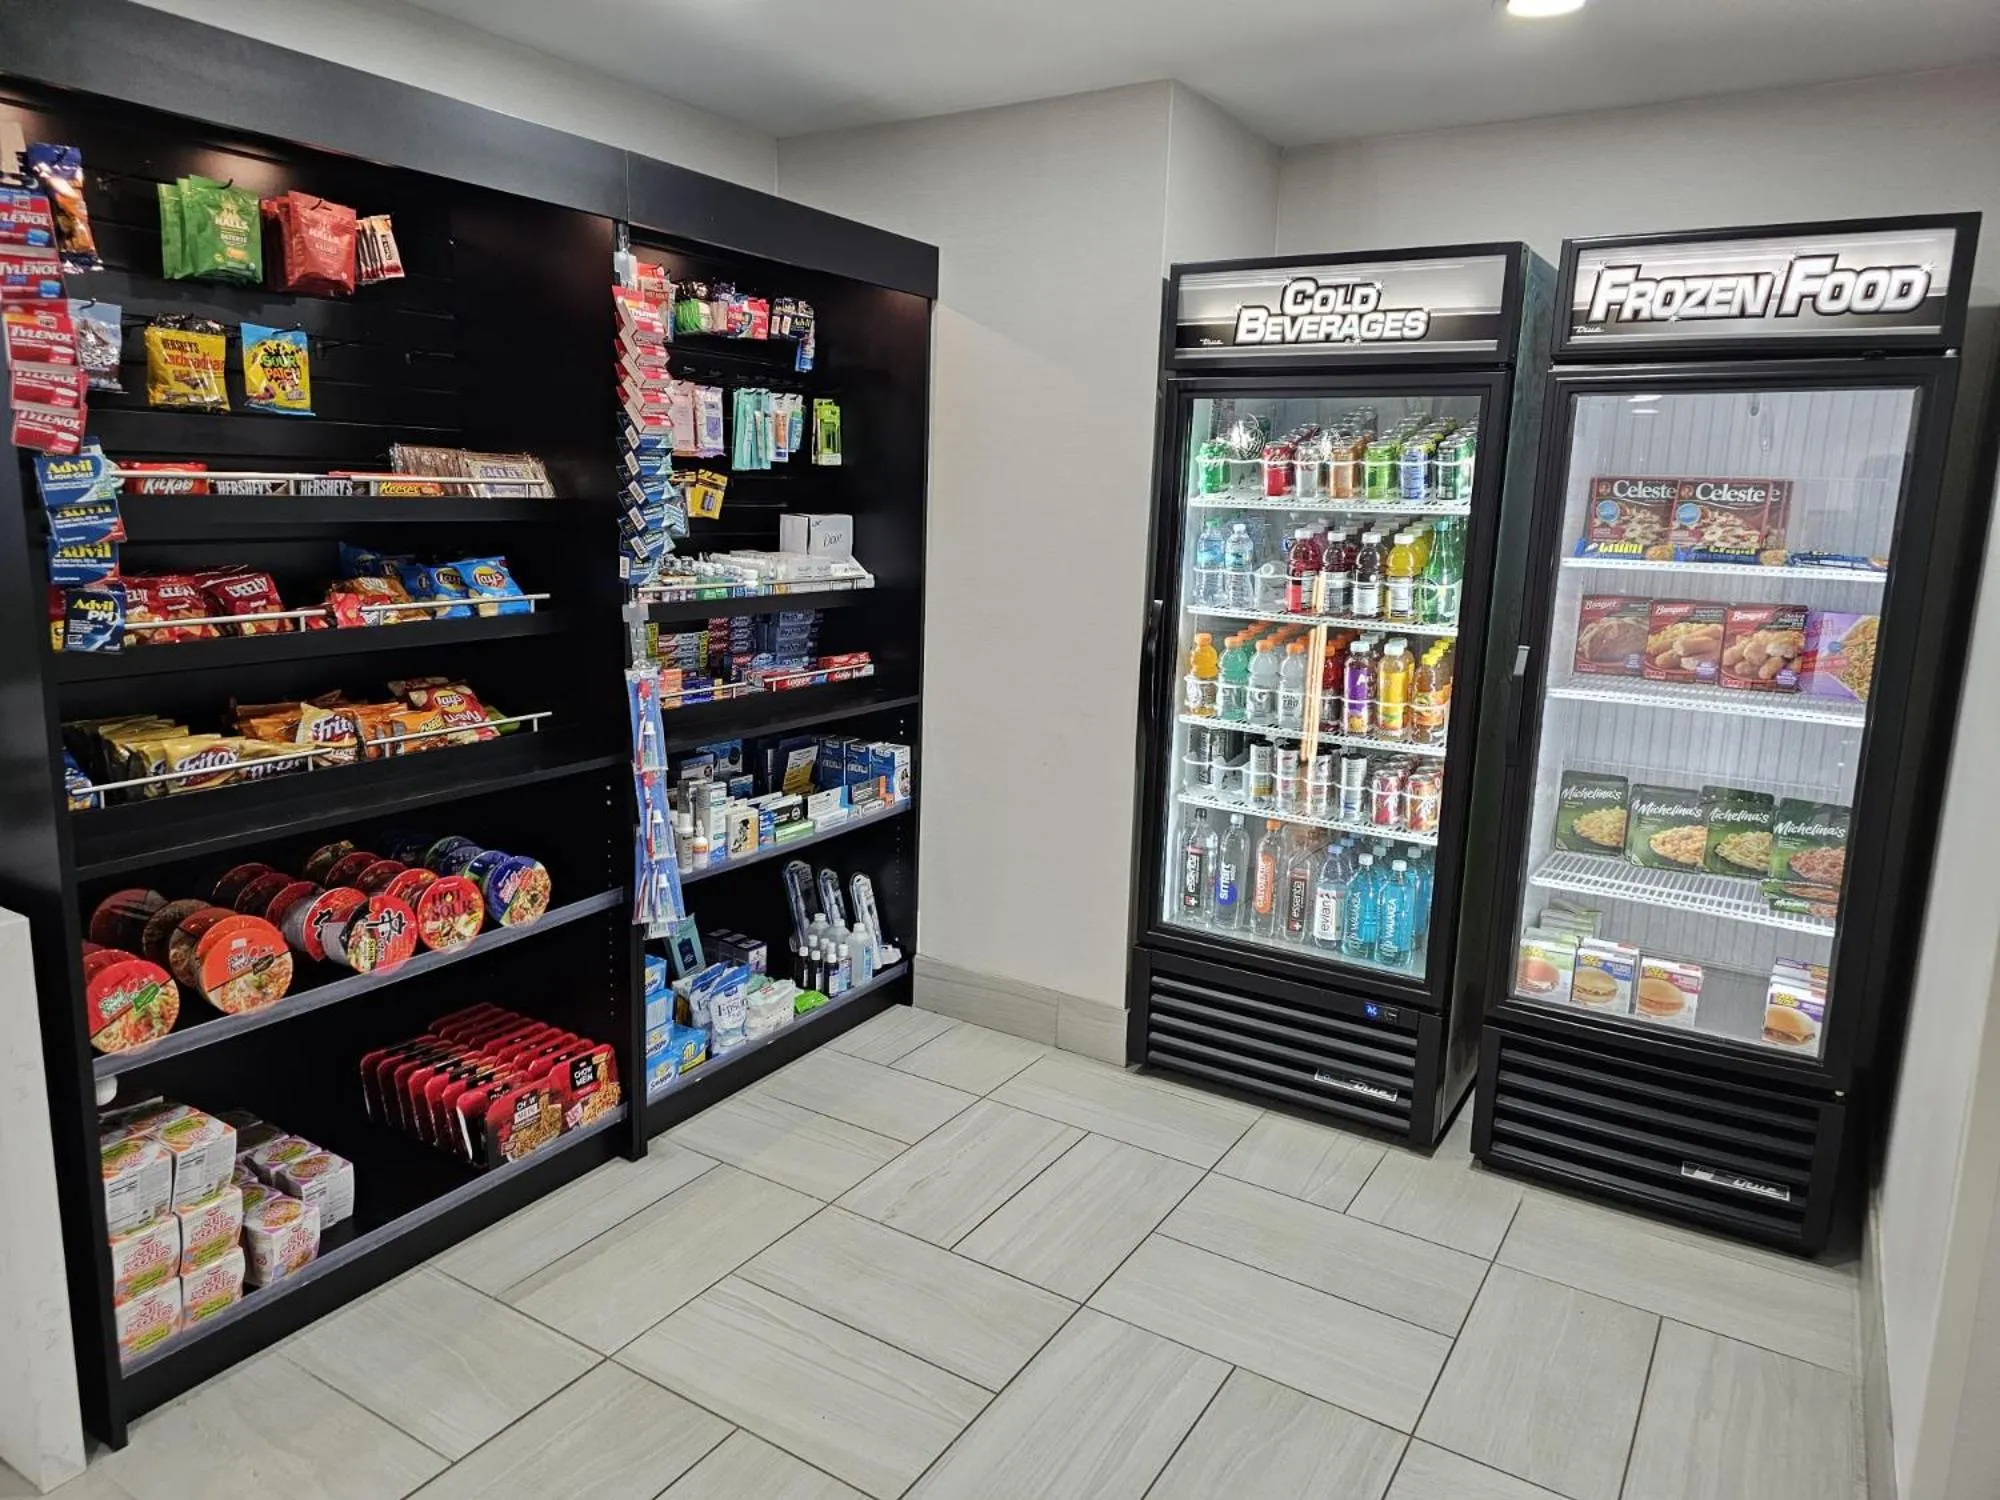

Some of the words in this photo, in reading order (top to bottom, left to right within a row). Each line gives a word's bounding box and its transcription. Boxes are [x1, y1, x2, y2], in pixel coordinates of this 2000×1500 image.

[1284, 278, 1380, 315] COLD
[1588, 264, 1773, 324] FROZEN
[1777, 253, 1931, 318] FOOD
[1236, 306, 1431, 343] BEVERAGES
[11, 327, 74, 343] TYLENOL
[262, 354, 297, 368] SOUR
[47, 458, 93, 474] Advil
[142, 478, 195, 495] KitKat
[216, 480, 274, 496] HERSHEY'S
[300, 479, 353, 496] HERSHEY'S
[1612, 479, 1678, 500] Celeste
[1695, 482, 1766, 502] Celeste
[72, 598, 115, 612] Advil
[87, 610, 115, 622] PM
[173, 749, 239, 786] Fritos
[1561, 785, 1622, 801] Michelina's
[1637, 801, 1703, 819] Michelina's
[1773, 820, 1847, 839] Michelina's
[1219, 862, 1232, 900] smart
[1291, 880, 1303, 919] essentia
